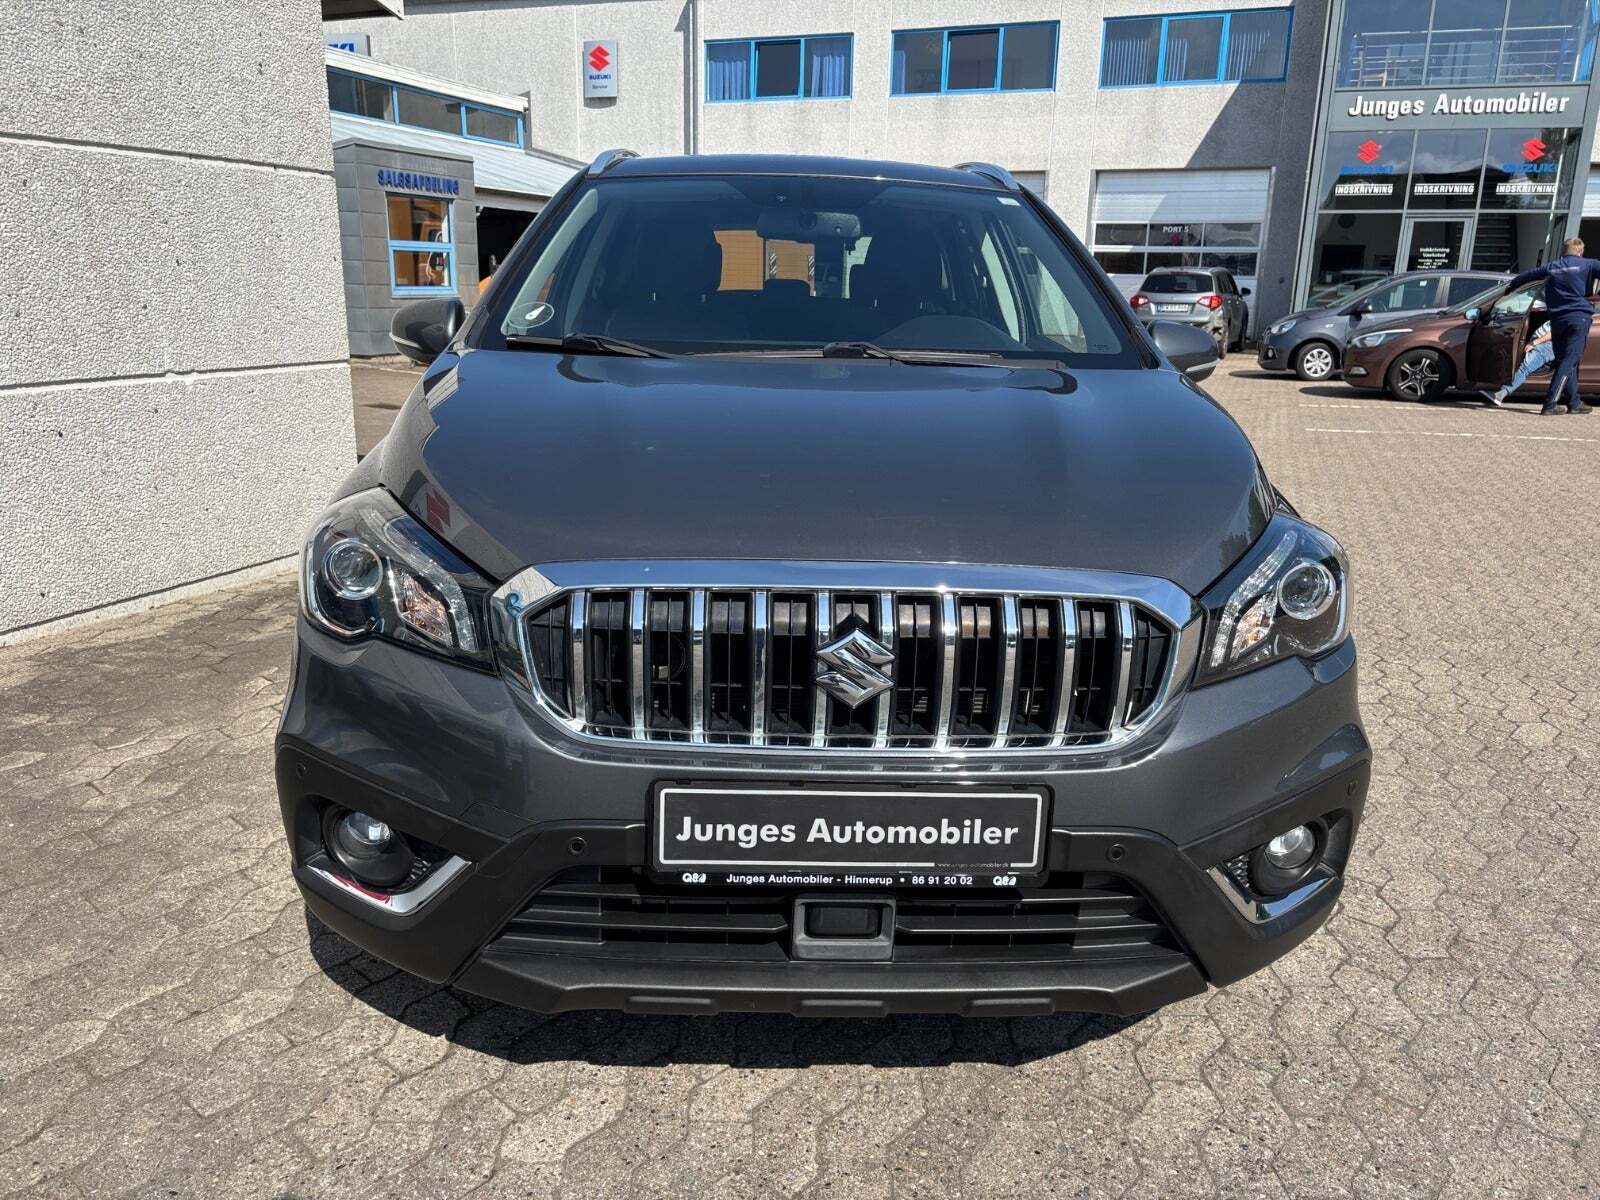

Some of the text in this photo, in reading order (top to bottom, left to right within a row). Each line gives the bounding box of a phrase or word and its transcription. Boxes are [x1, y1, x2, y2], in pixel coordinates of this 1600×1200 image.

[1348, 91, 1570, 120] Junges Automobiler
[1335, 184, 1393, 195] INDSKRIVNING
[1414, 184, 1475, 194] INDSKRIVNING
[675, 815, 1019, 849] Junges Automobiler
[726, 874, 765, 885] Junges
[768, 874, 834, 884] Automobiler
[844, 874, 893, 886] Hinnerup
[911, 875, 973, 885] 86 91 20 02
